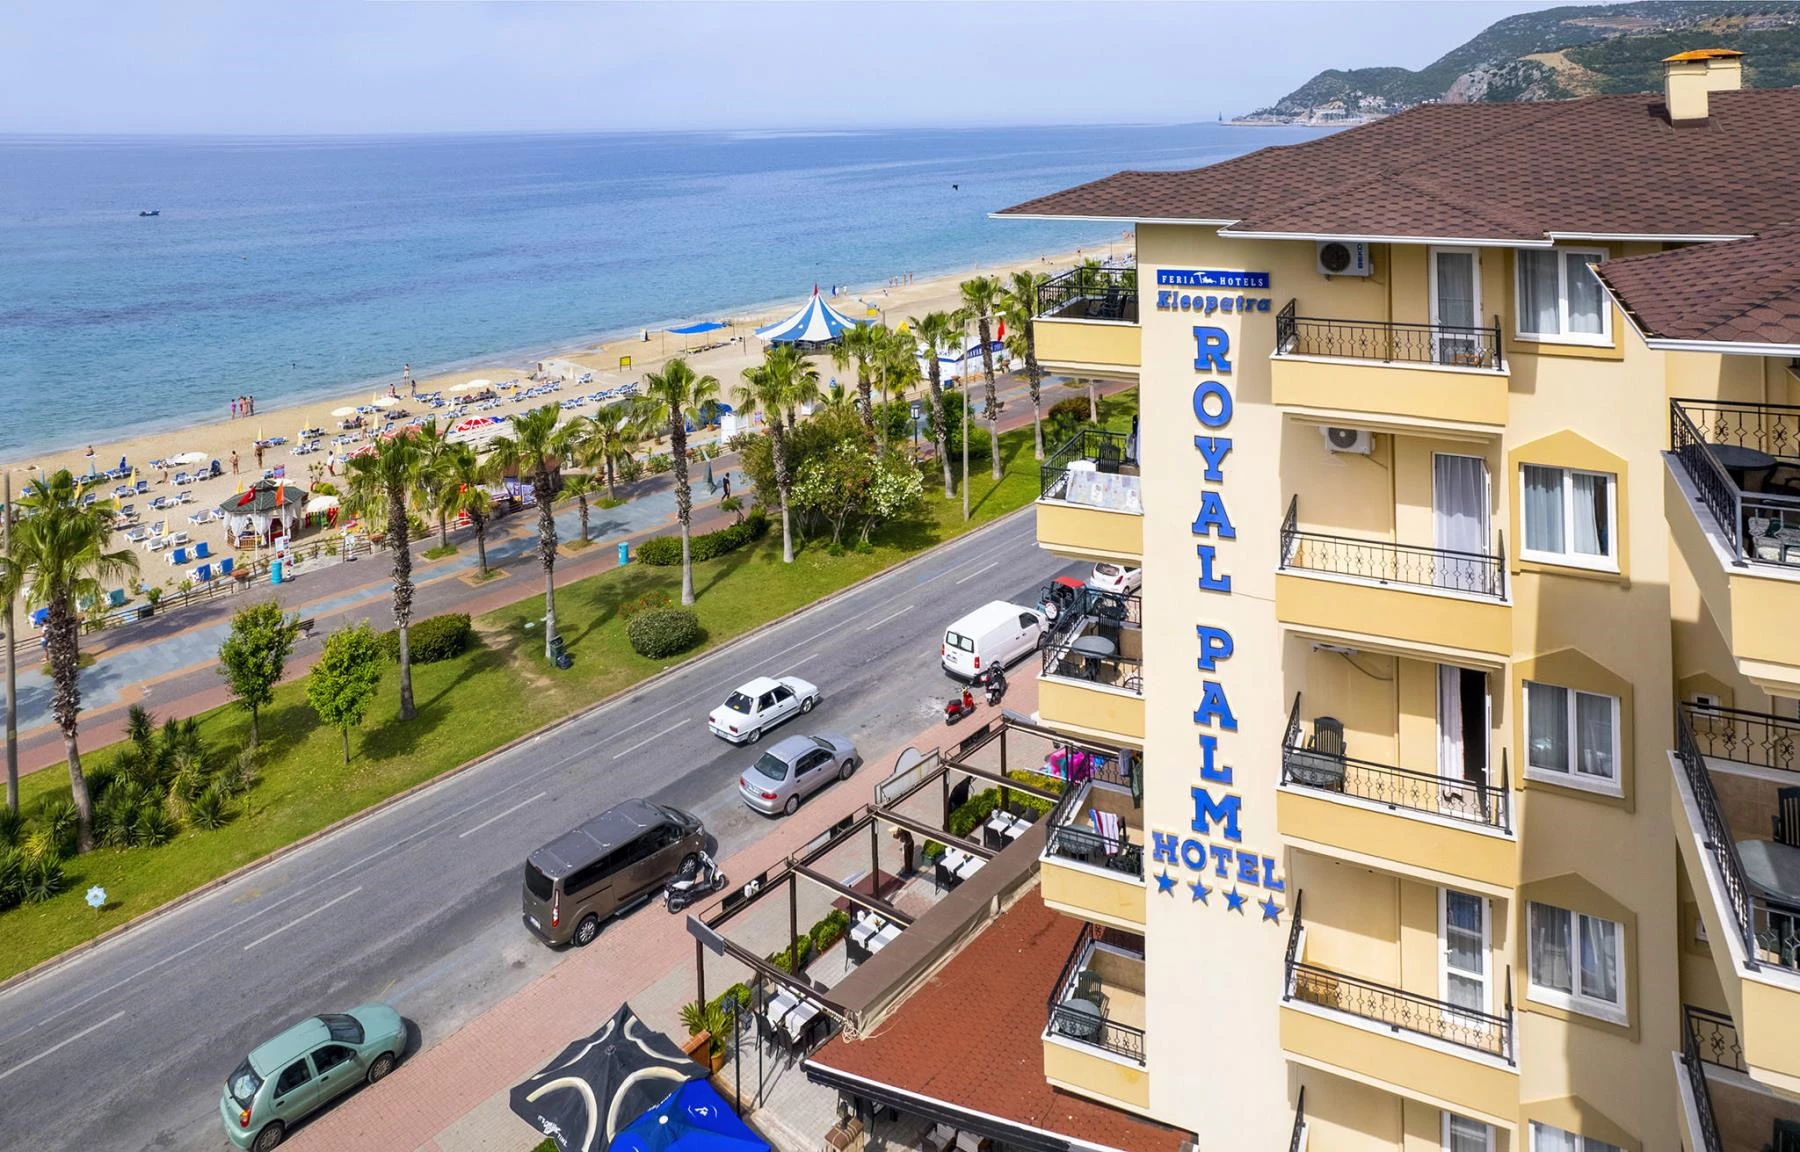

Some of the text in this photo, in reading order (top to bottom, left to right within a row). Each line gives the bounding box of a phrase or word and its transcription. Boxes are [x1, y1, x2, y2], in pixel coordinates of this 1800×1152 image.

[1156, 290, 1272, 315] Kleopatra
[1161, 275, 1264, 287] FERIA HOTELS
[1191, 325, 1237, 593] ROYAL
[1191, 624, 1242, 843] PALM
[1151, 830, 1286, 893] HOTEL
